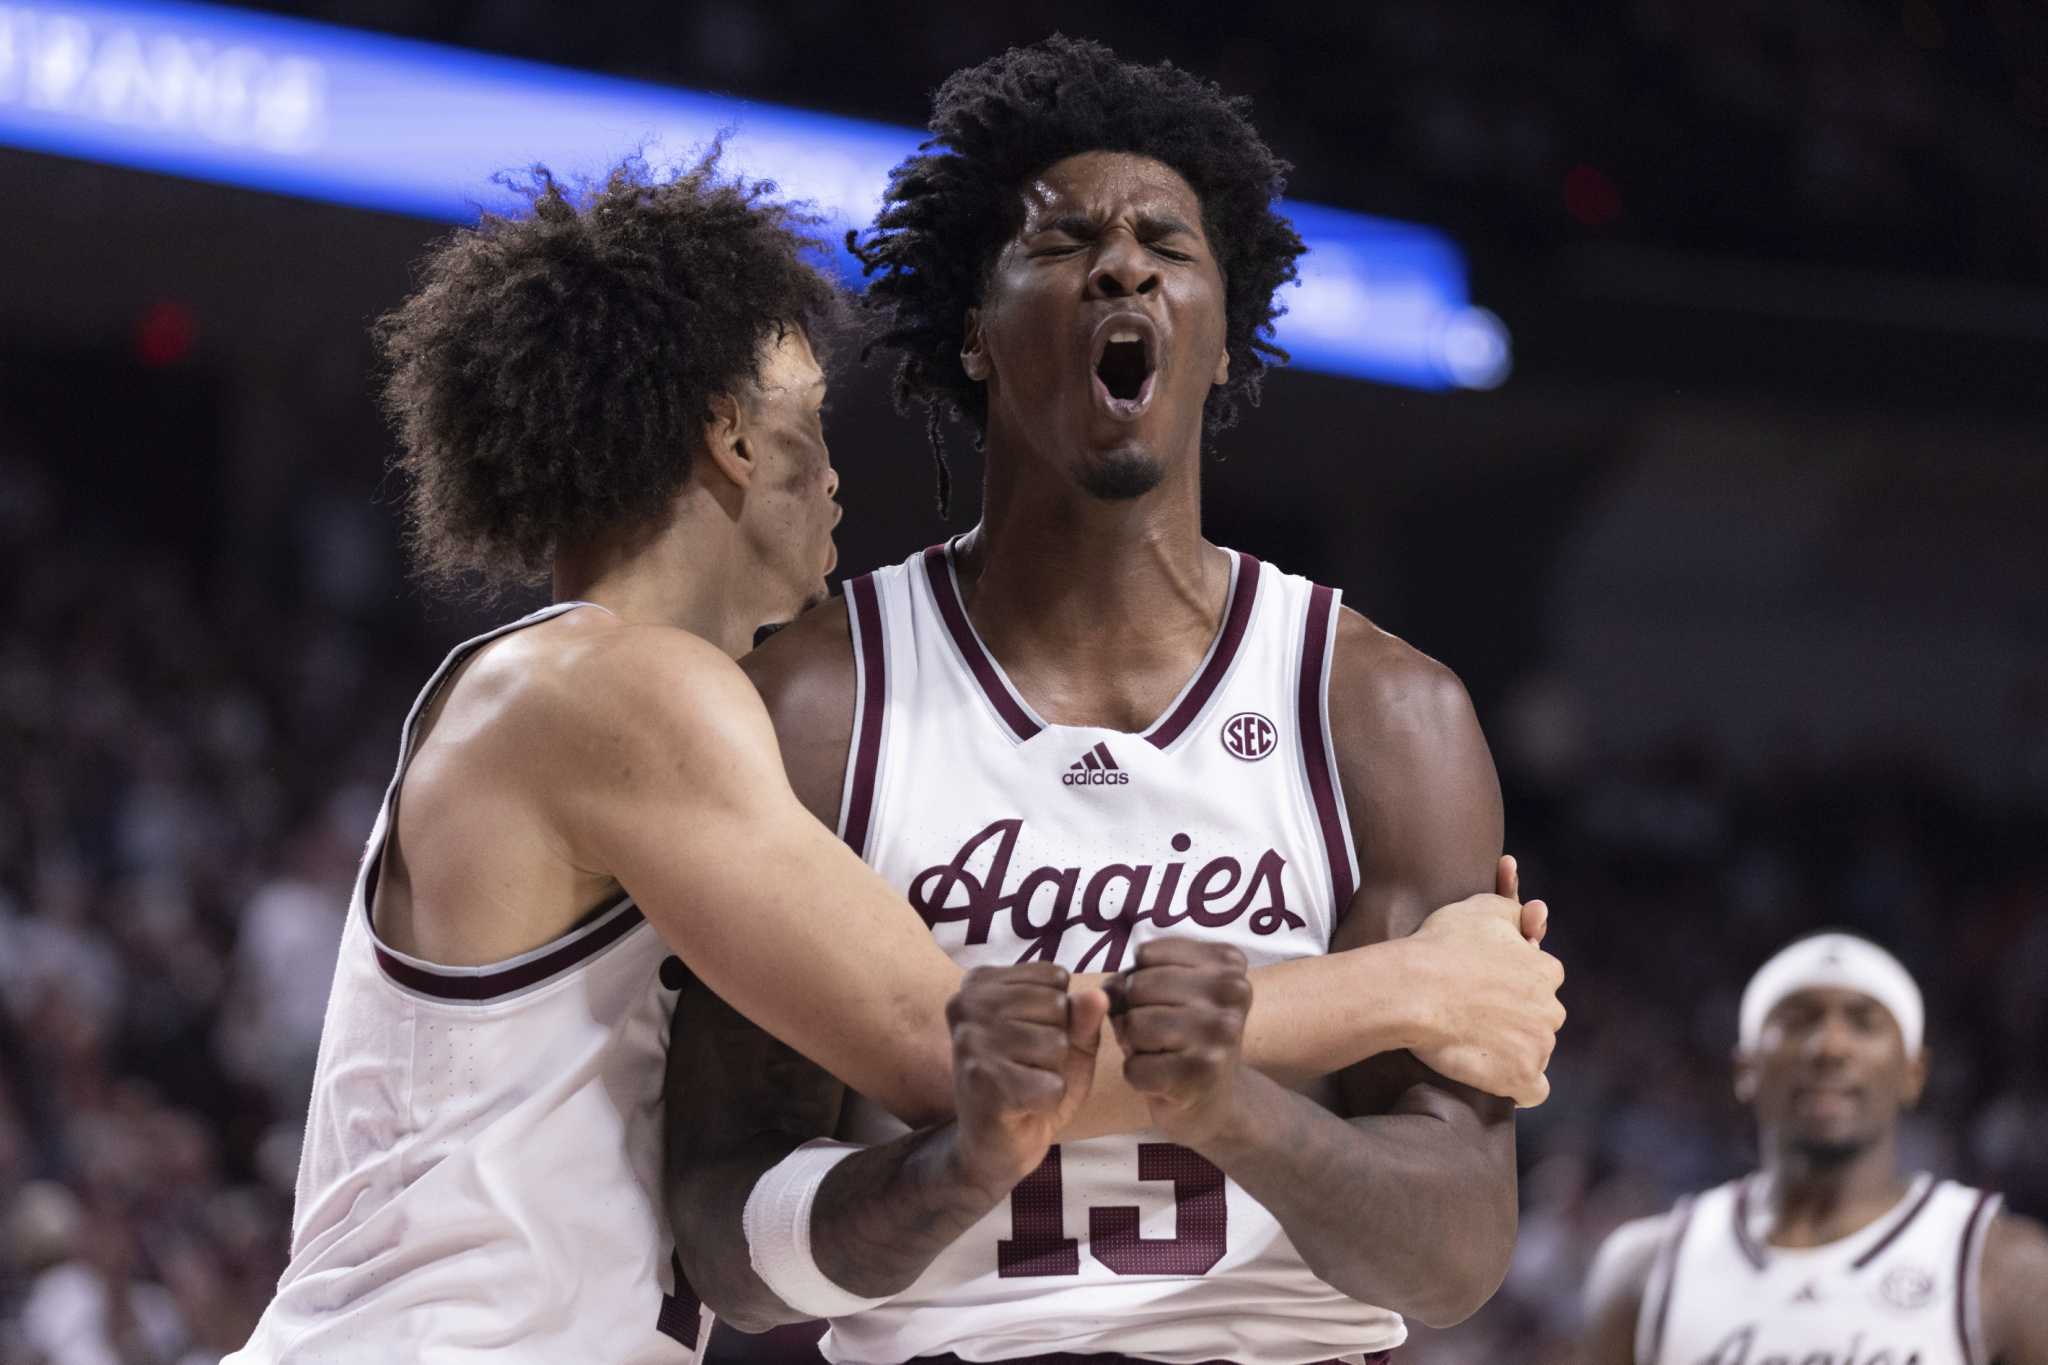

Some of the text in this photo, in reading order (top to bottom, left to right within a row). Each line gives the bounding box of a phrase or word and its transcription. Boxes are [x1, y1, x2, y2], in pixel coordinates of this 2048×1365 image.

[1226, 716, 1273, 757] SEC
[1062, 769, 1129, 786] adidas
[908, 818, 1307, 973] Aggies
